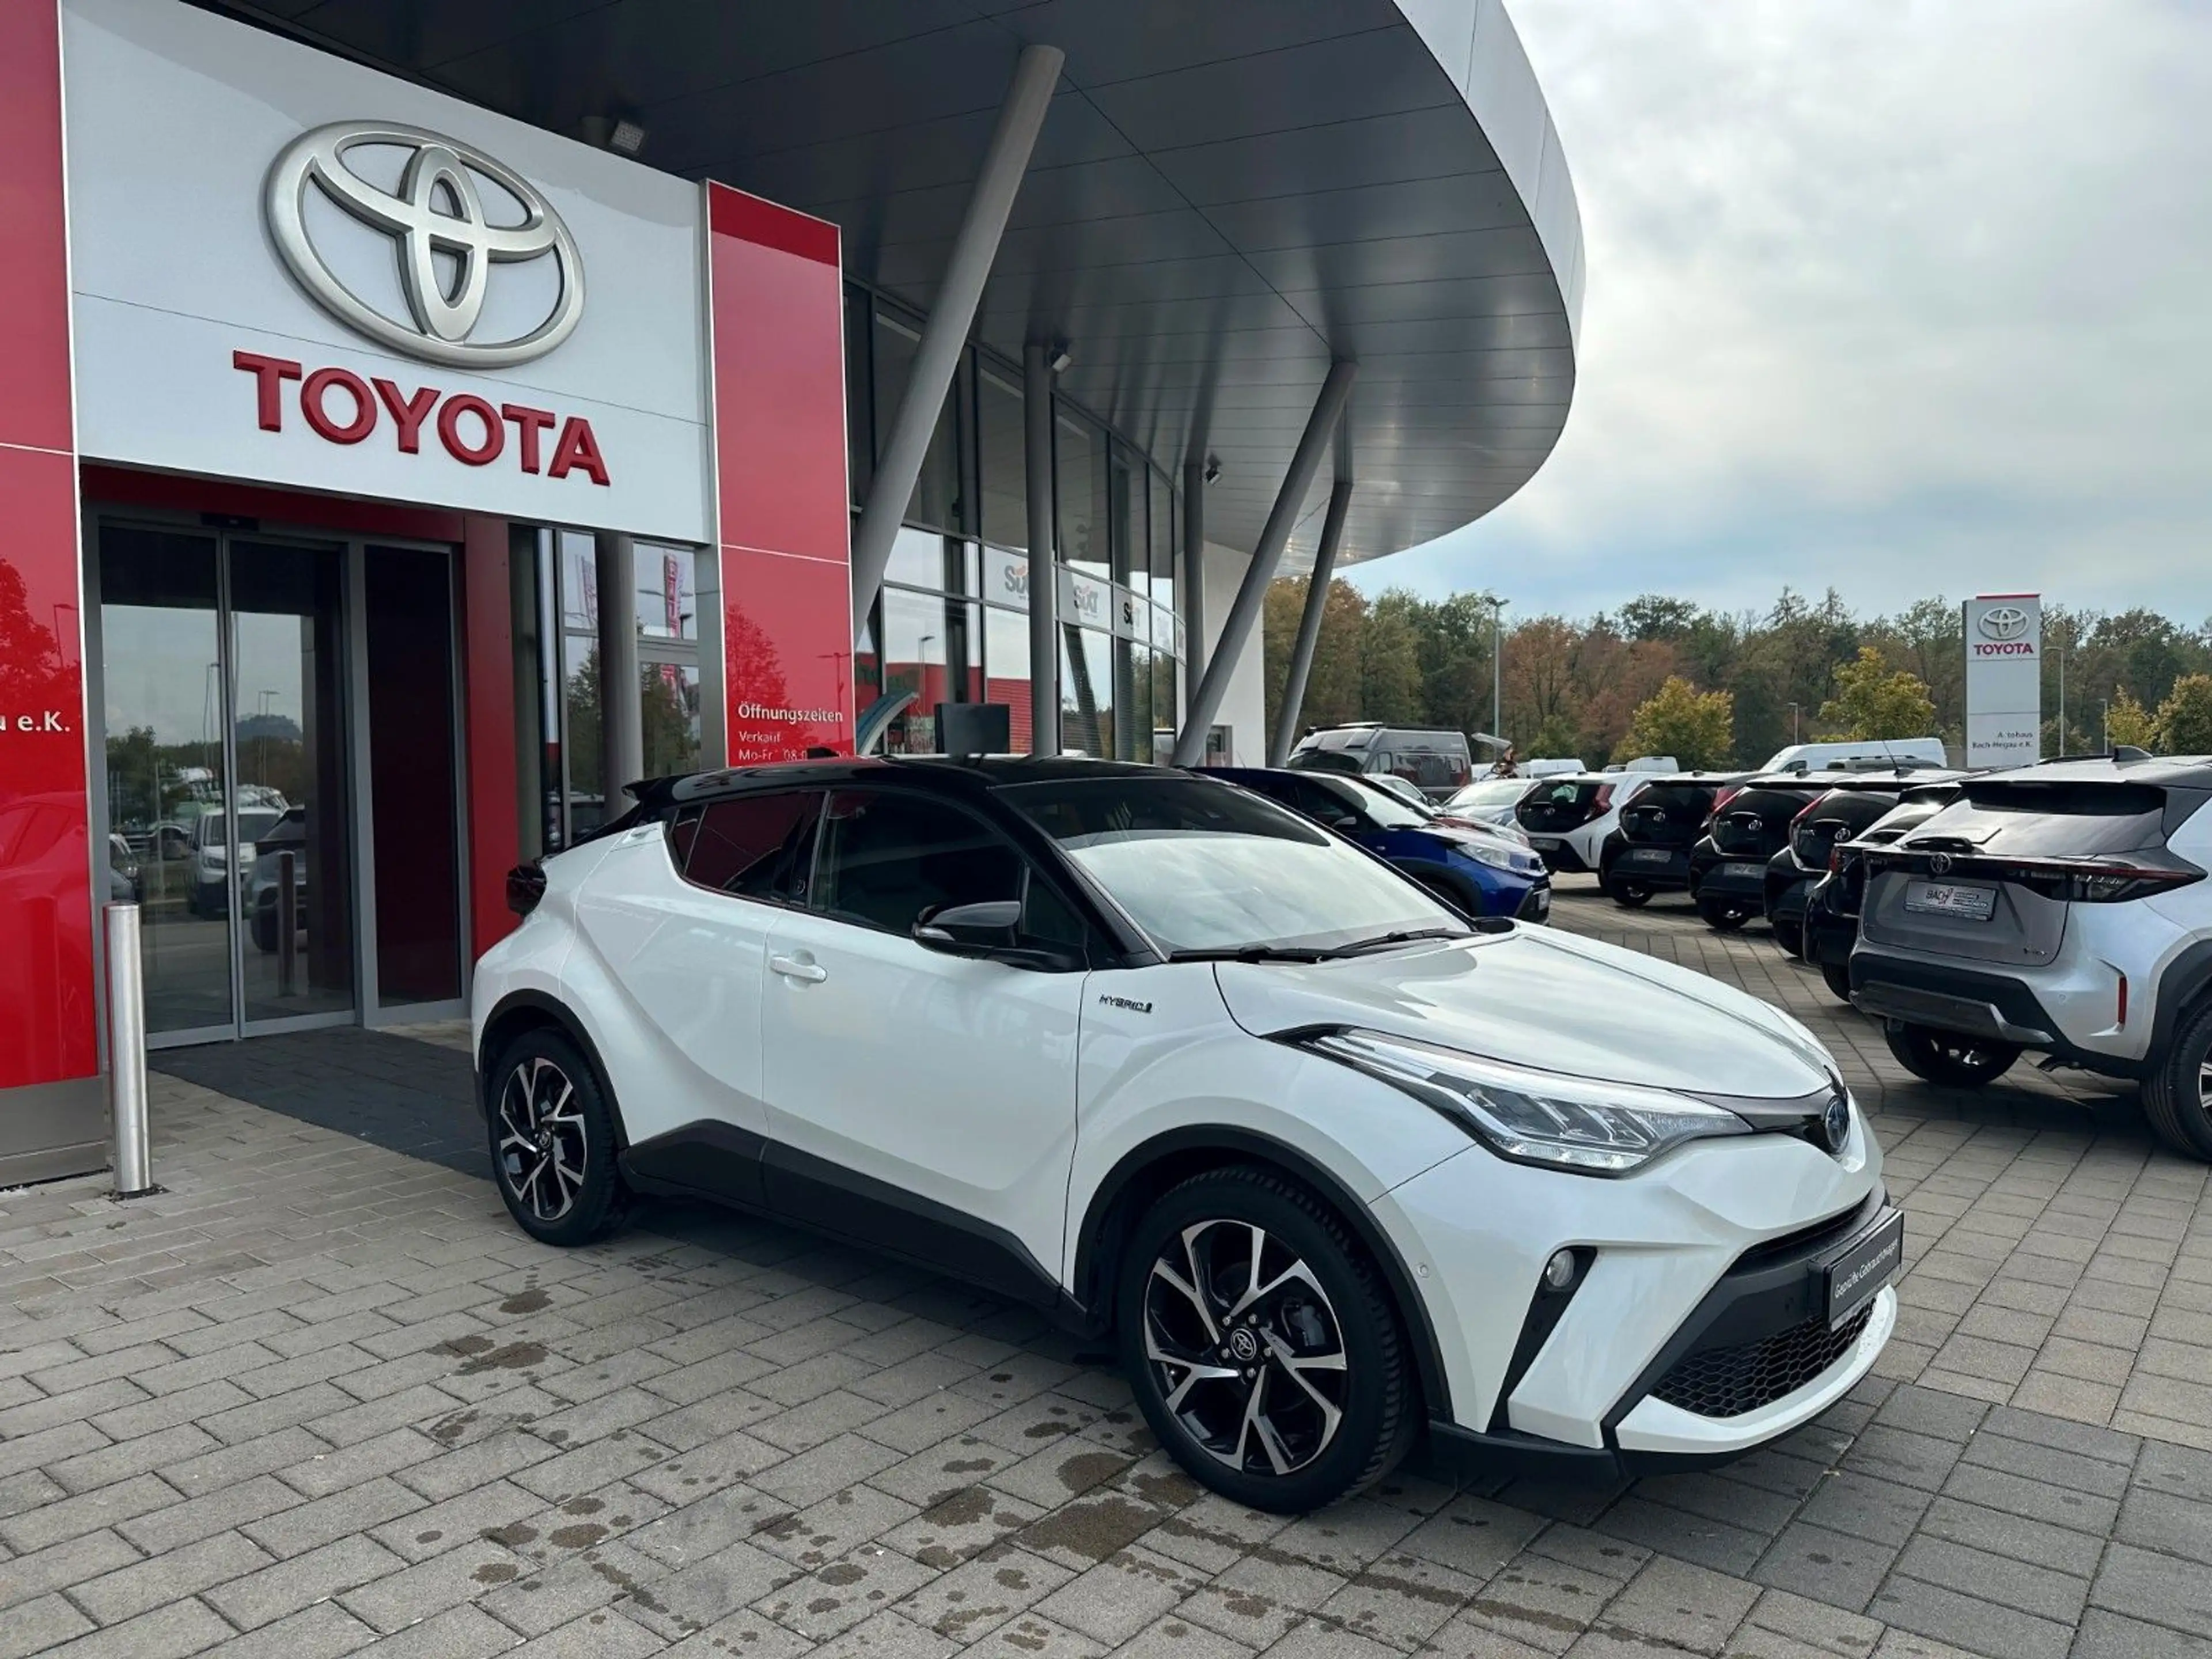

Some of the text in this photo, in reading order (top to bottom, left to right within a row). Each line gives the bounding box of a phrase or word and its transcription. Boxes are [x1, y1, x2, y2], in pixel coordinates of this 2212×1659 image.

[233, 350, 610, 487] TOYOTA
[1974, 643, 2033, 656] TOYOTA
[18, 710, 70, 732] e.K.
[738, 701, 843, 725] Öffnungszeiten
[738, 731, 781, 743] Verkauf
[738, 749, 773, 761] Mo-Fr
[1099, 994, 1144, 1012] HYBRID
